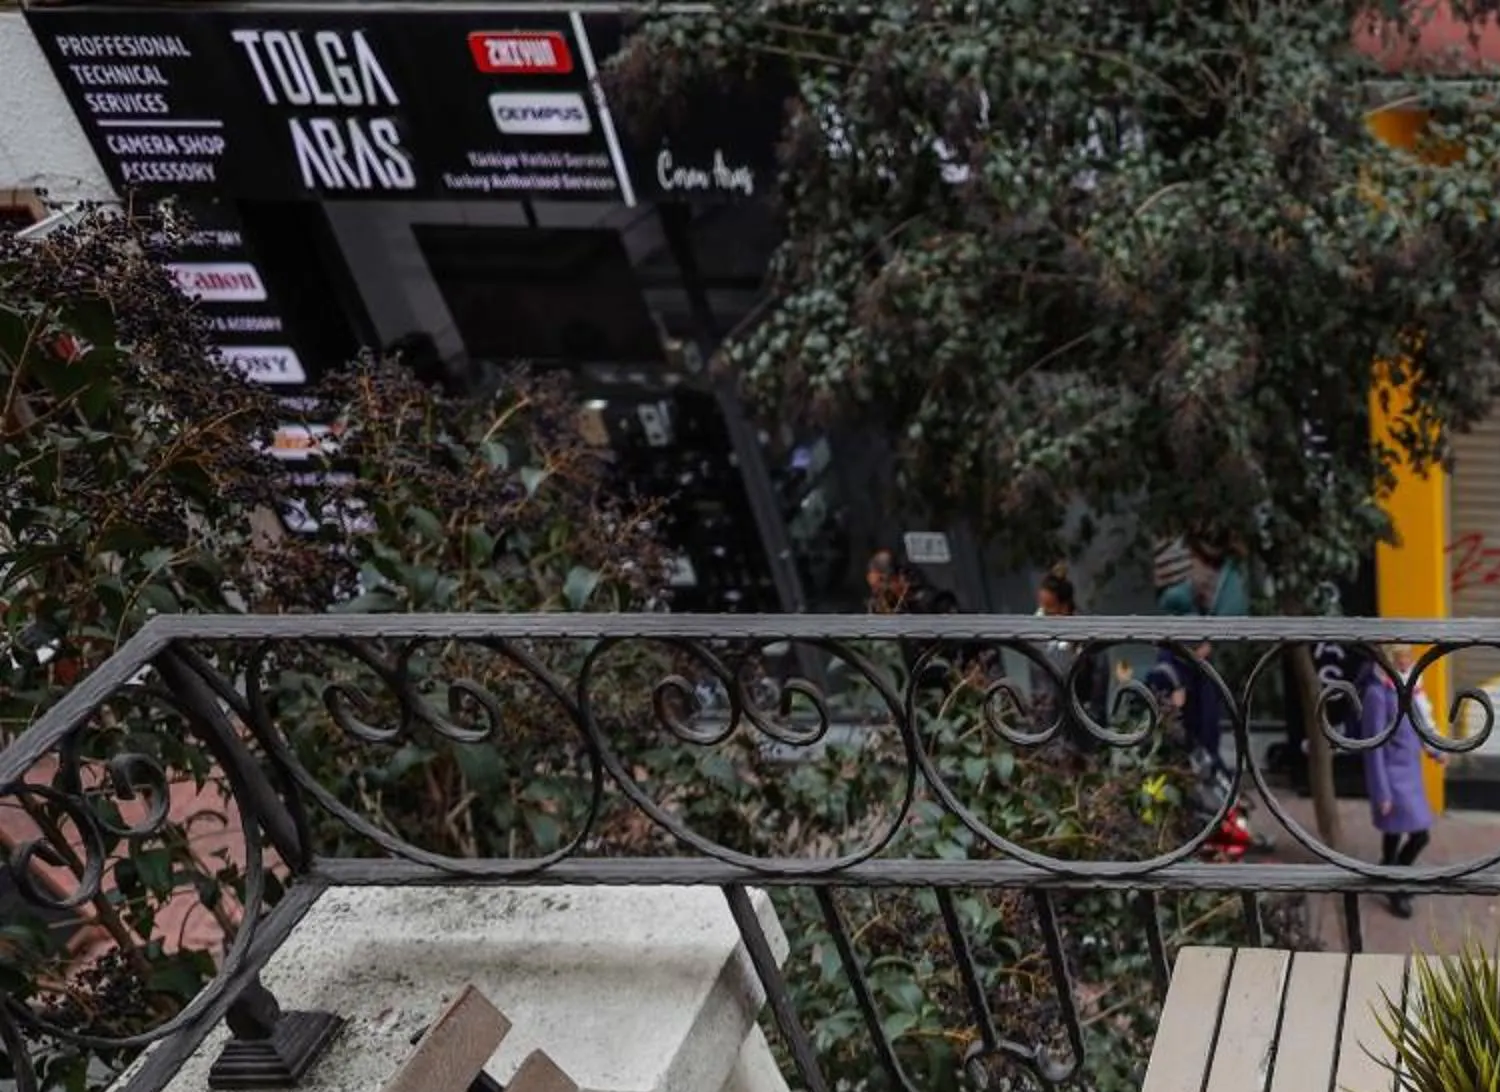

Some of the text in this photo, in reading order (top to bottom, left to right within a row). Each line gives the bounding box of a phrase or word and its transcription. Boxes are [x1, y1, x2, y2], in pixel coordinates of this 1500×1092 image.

[55, 35, 192, 57] PROFFESIONAL
[69, 64, 169, 85] TECHNICAL
[230, 30, 400, 105] TOLGA
[83, 92, 169, 113] SERVICES
[498, 107, 583, 121] OLYMPUS
[105, 134, 226, 155] CAMERA SHOP
[288, 117, 416, 189] ARAS
[121, 162, 216, 182] ACCESSORY
